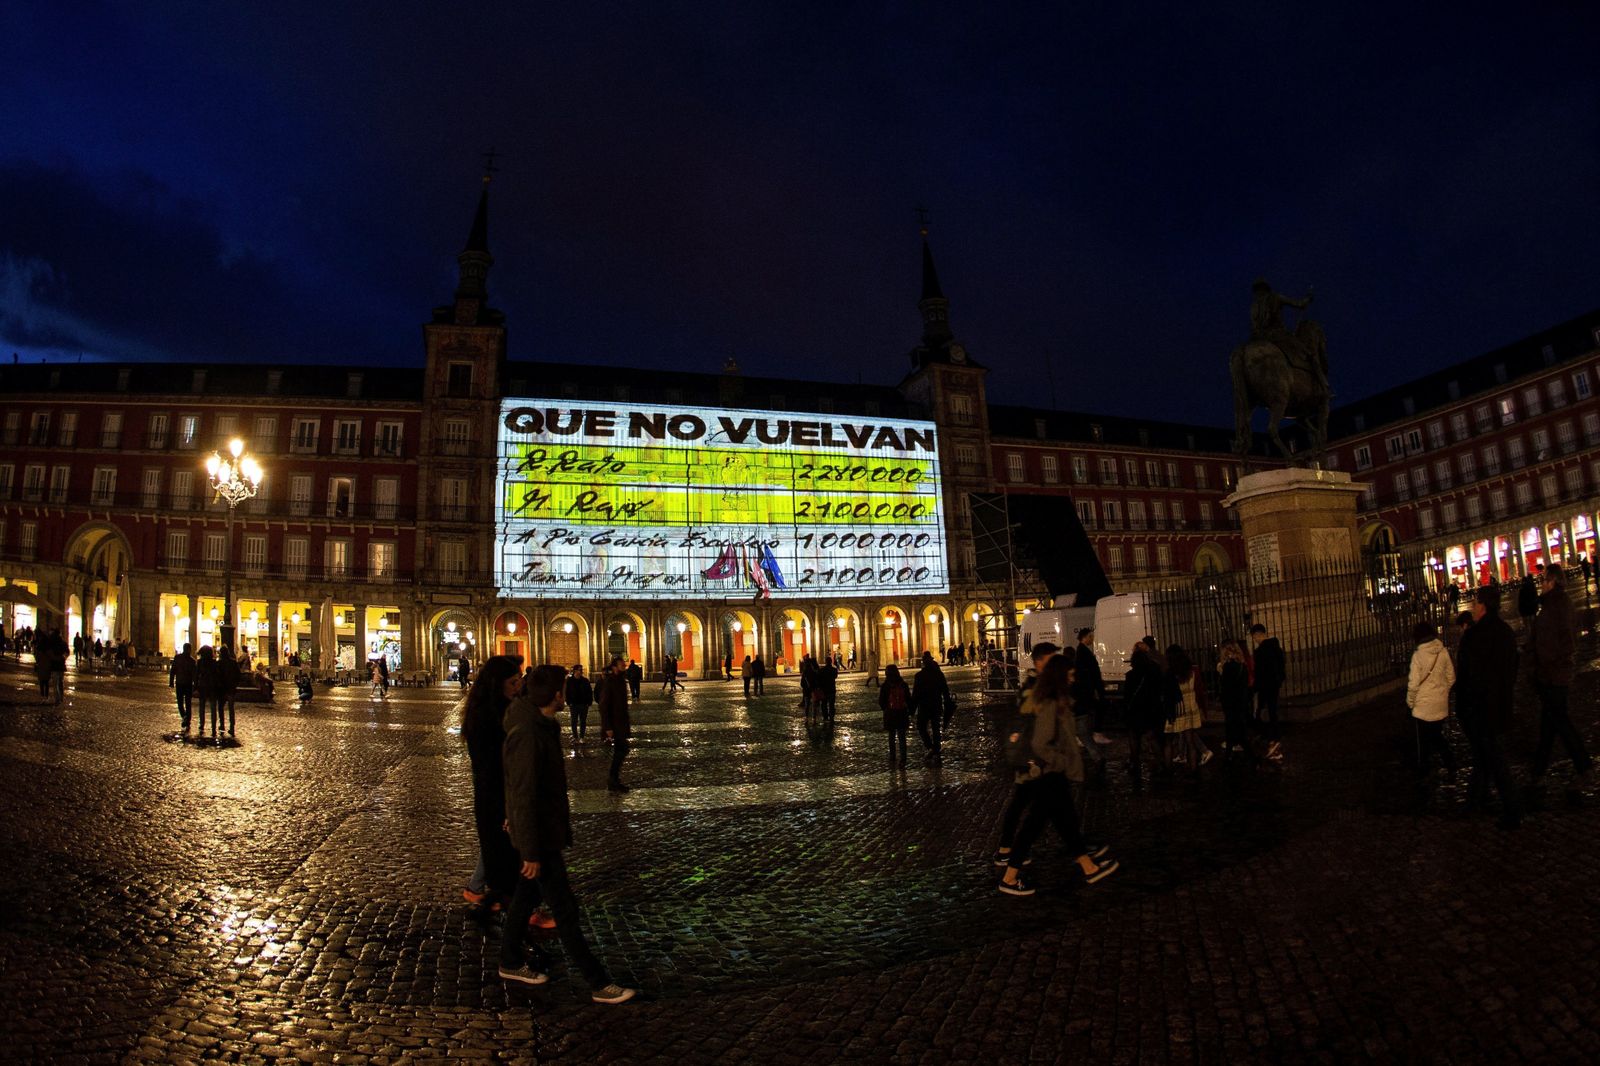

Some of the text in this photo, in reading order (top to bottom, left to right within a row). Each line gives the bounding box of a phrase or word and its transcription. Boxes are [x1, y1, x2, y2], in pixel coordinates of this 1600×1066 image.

[505, 407, 936, 452] QUE NO VUELVAN
